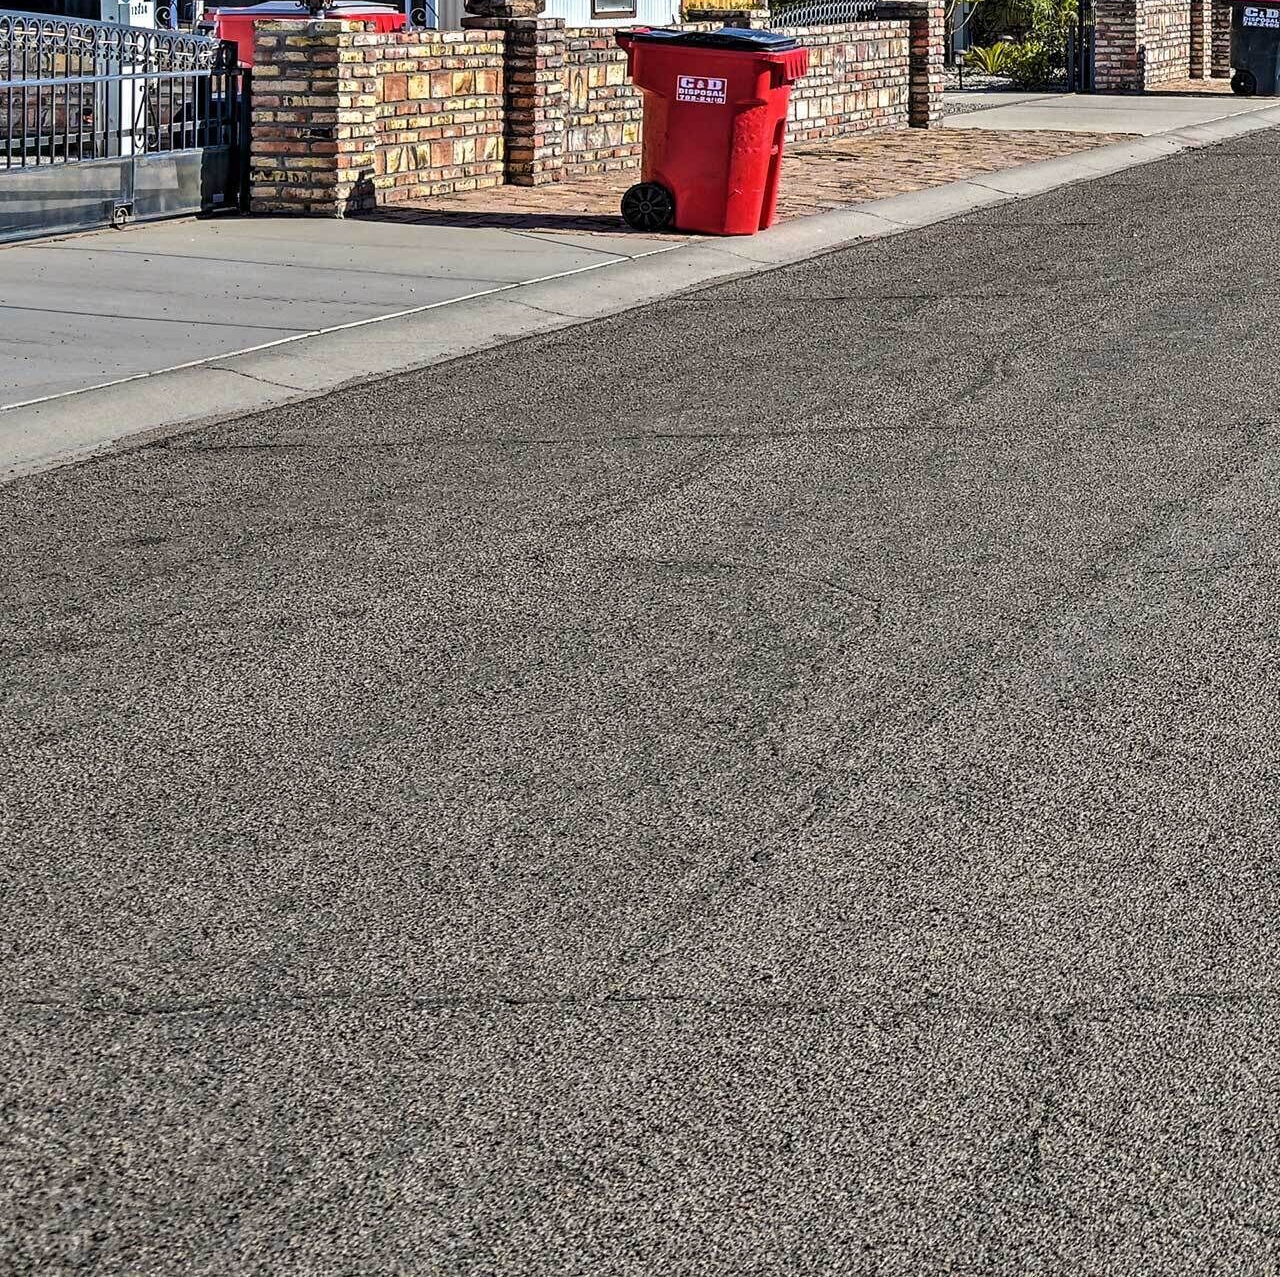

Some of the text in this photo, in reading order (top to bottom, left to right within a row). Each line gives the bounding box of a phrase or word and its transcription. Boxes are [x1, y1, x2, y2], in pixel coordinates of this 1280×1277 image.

[1245, 7, 1258, 17] C
[1266, 8, 1279, 19] D
[1243, 16, 1280, 24] DISPOSAL
[680, 78, 722, 90] C & D
[678, 88, 725, 97] DISPOSAL
